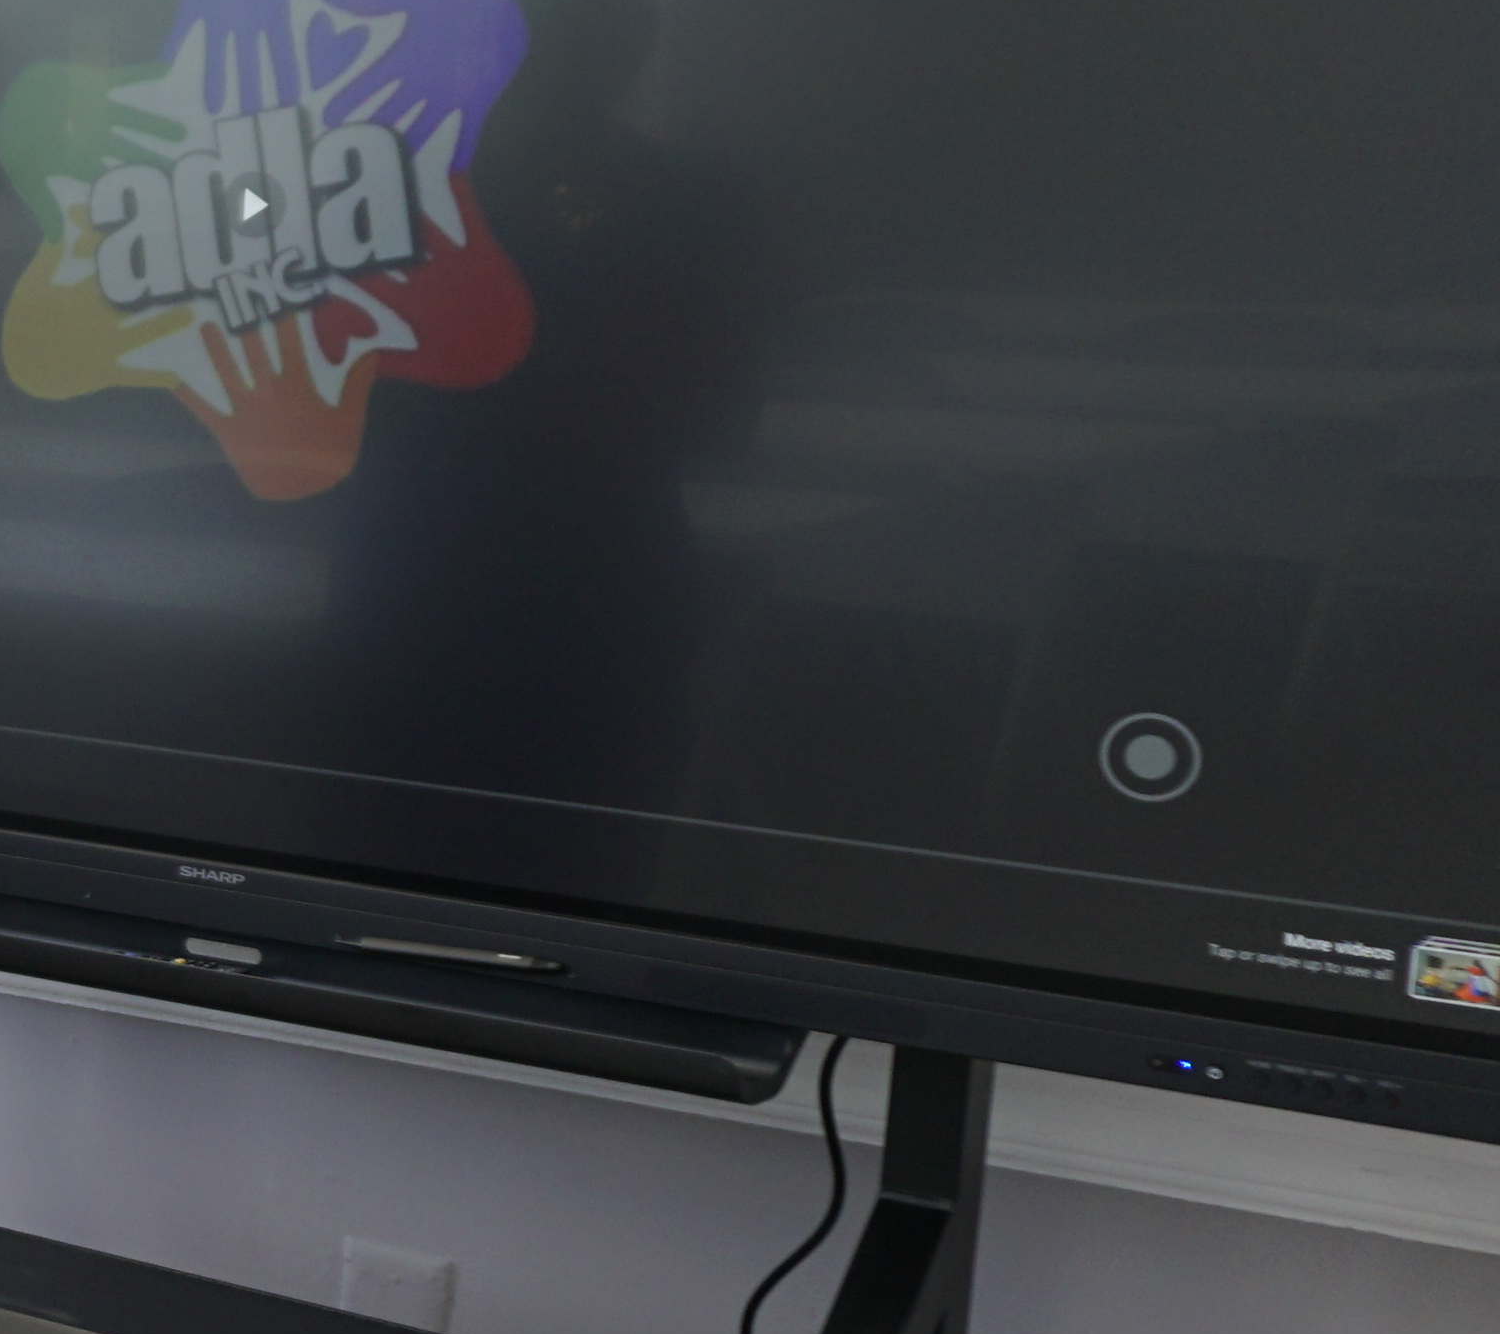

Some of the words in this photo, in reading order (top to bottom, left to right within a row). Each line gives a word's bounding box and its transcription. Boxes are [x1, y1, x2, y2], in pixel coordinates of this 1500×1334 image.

[90, 104, 414, 305] adla
[179, 865, 246, 884] SHARP
[1282, 931, 1334, 953] More
[1334, 939, 1397, 961] videos
